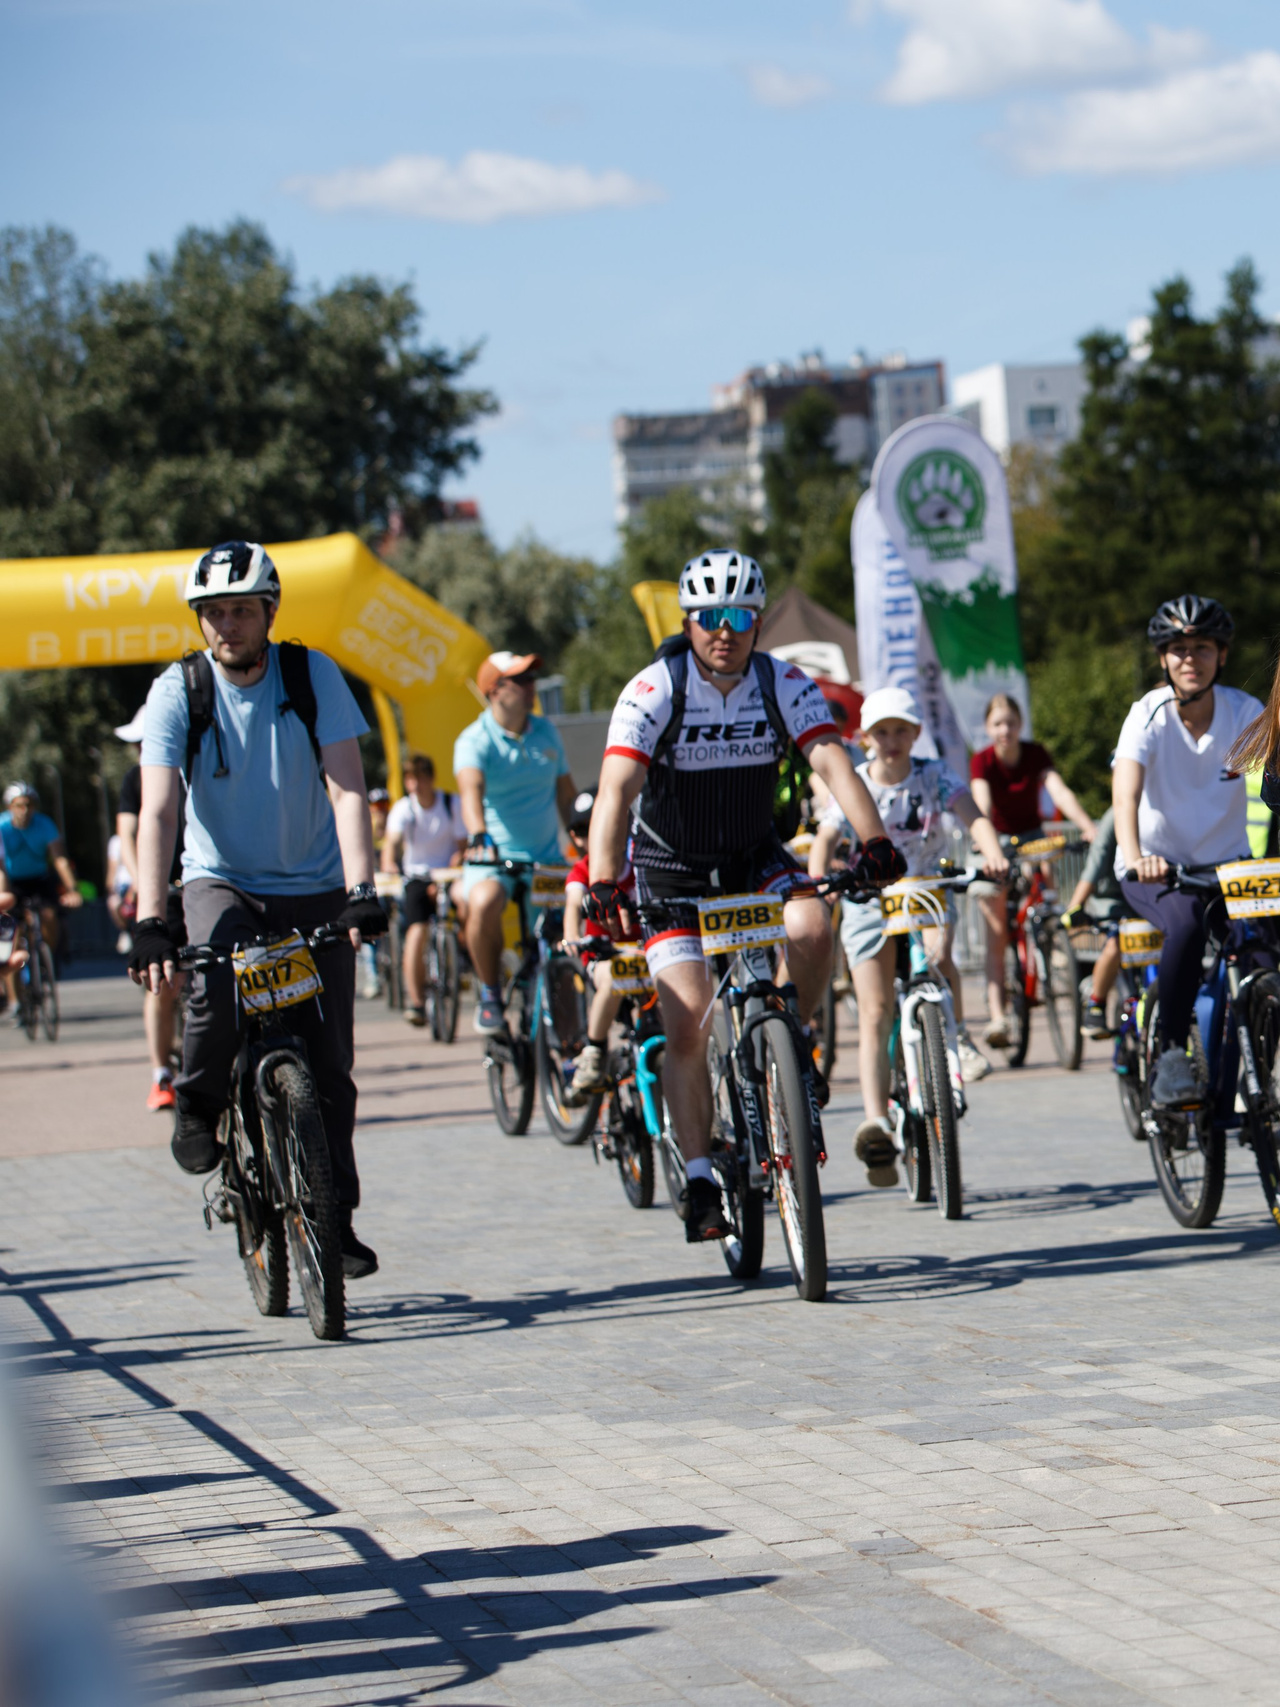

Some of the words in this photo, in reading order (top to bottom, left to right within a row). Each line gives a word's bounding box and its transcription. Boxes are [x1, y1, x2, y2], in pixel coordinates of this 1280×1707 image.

[63, 562, 193, 612] КРУТ
[28, 631, 61, 665] В
[77, 622, 207, 662] ПЕР
[704, 906, 770, 931] 0788
[243, 960, 291, 991] 1017
